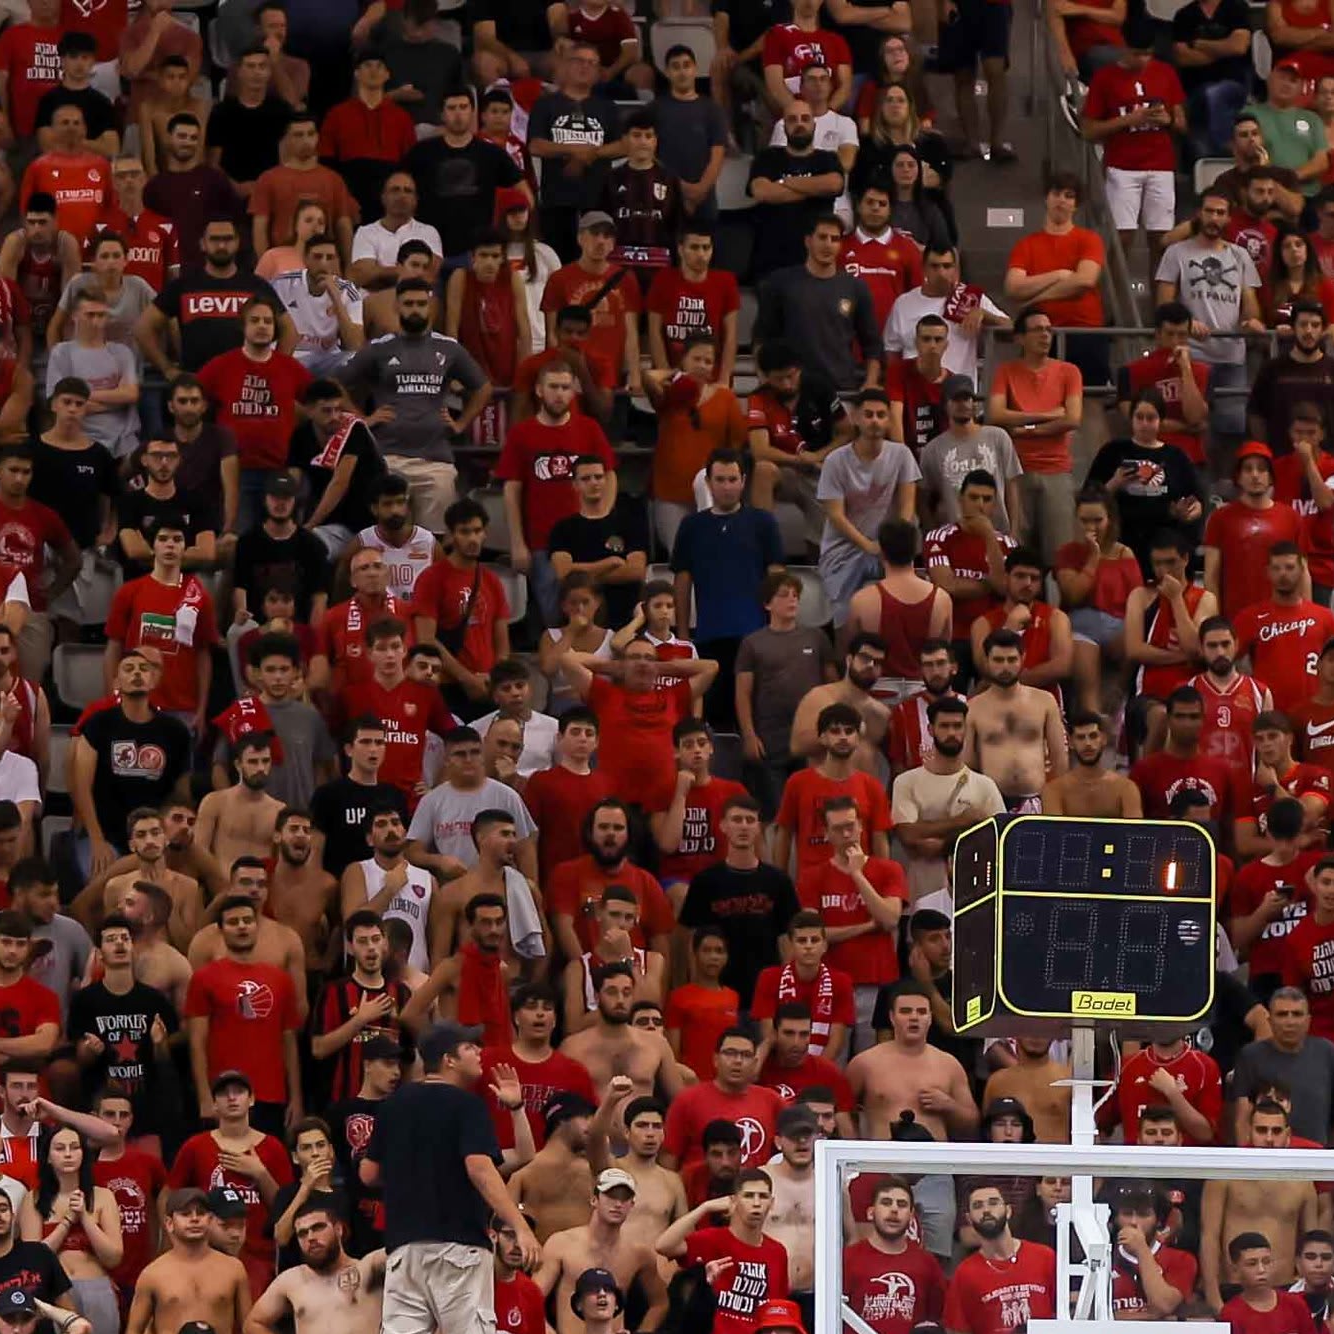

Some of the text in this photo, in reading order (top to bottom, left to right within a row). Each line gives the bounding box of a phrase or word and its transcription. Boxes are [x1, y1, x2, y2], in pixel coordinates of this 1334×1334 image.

[395, 374, 444, 385] TURKISH
[396, 383, 442, 395] AIRLINES
[1259, 618, 1316, 642] Chicago
[1076, 993, 1133, 1014] Bodet
[95, 1013, 148, 1034] WORKERS
[108, 1031, 121, 1042] OF
[732, 1277, 768, 1295] לעולם
